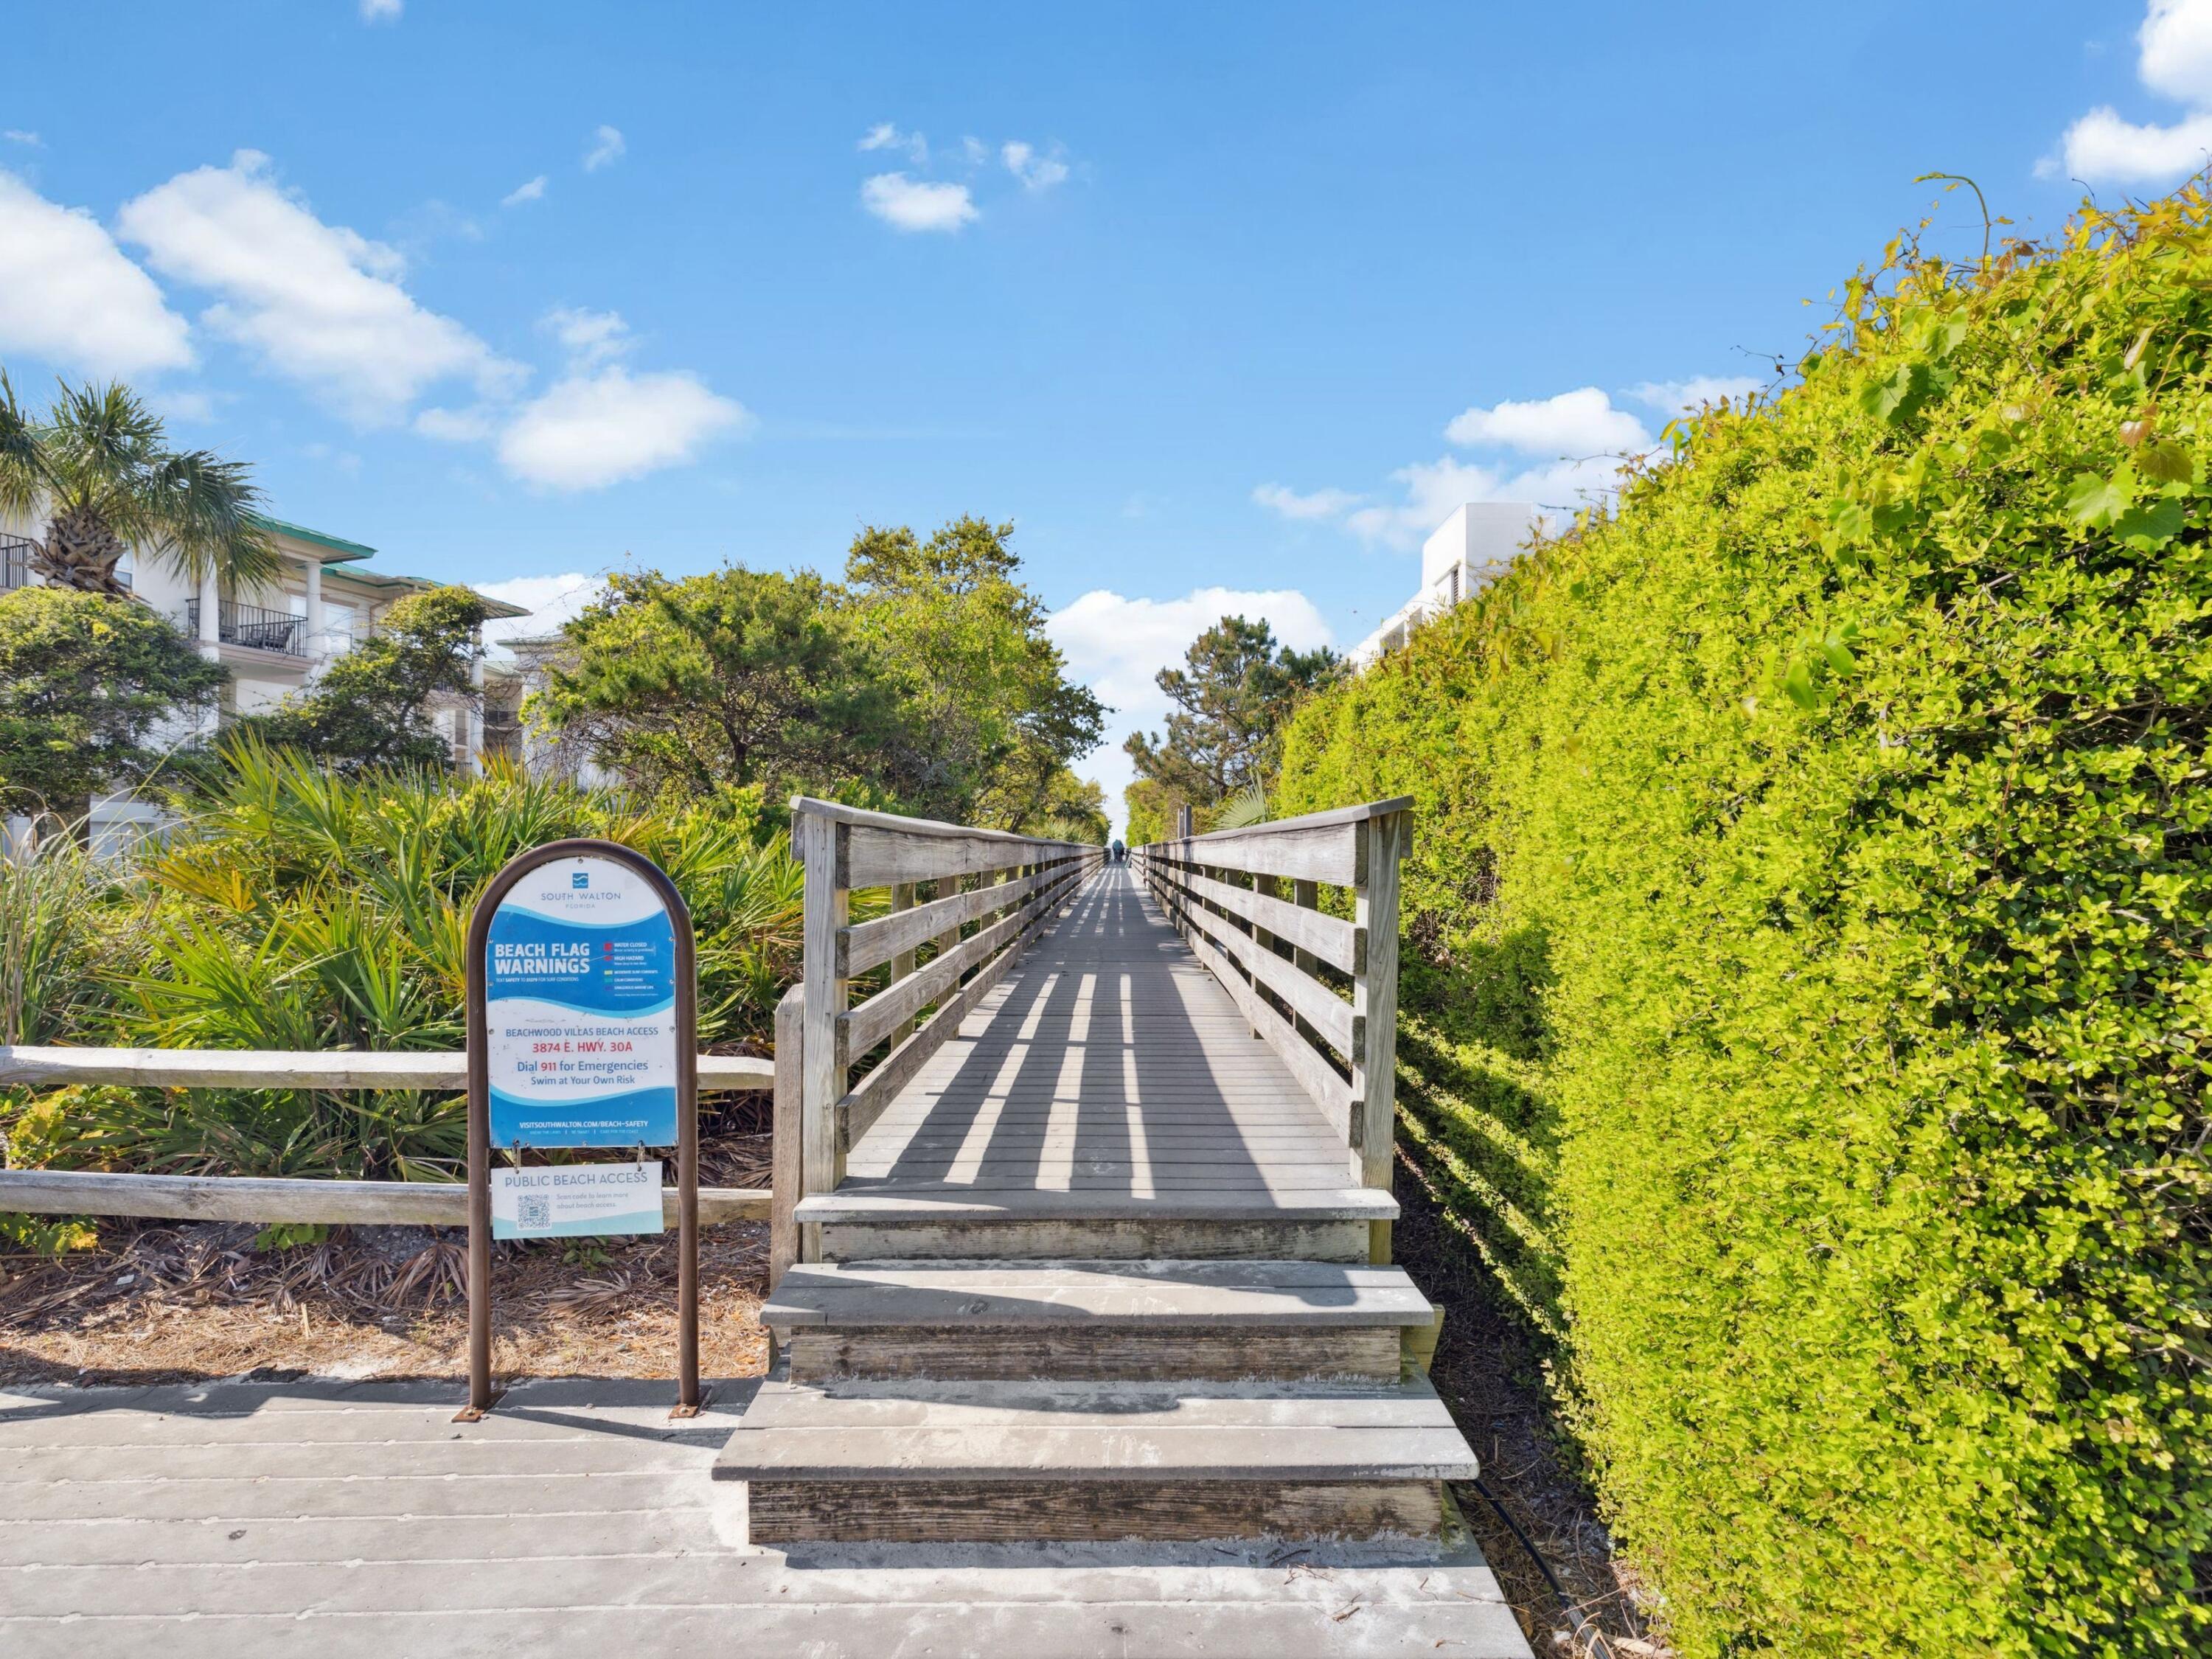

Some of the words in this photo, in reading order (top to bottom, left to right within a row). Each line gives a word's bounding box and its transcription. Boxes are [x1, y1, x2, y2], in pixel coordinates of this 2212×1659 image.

[540, 892, 574, 900] SOUTH
[579, 892, 621, 900] WALTON
[495, 944, 546, 957] BEACH
[552, 943, 590, 956] FLAG
[495, 958, 591, 975] WARNINGS
[506, 1028, 562, 1037] BEACHWOOD
[564, 1028, 594, 1036] VILLAS
[596, 1027, 625, 1036] BEACH
[627, 1026, 658, 1035] ACCESS
[532, 1043, 560, 1053] 3874
[564, 1042, 574, 1052] E.
[577, 1042, 606, 1052] HWY.
[611, 1041, 633, 1052] 30A
[518, 1061, 538, 1071] Dial
[540, 1062, 557, 1071] 911
[560, 1061, 575, 1071] for
[578, 1060, 649, 1074] Emergencies
[531, 1076, 557, 1085] Swim
[570, 1076, 591, 1085] Your
[593, 1076, 614, 1085] Own
[617, 1075, 635, 1084] Risk
[519, 1120, 649, 1129] VISITSOUTHWALTON.COM/BEACH-SAFETY
[505, 1175, 550, 1187] PUBLIC
[554, 1174, 596, 1186] BEACH
[599, 1172, 648, 1184] ACCESS
